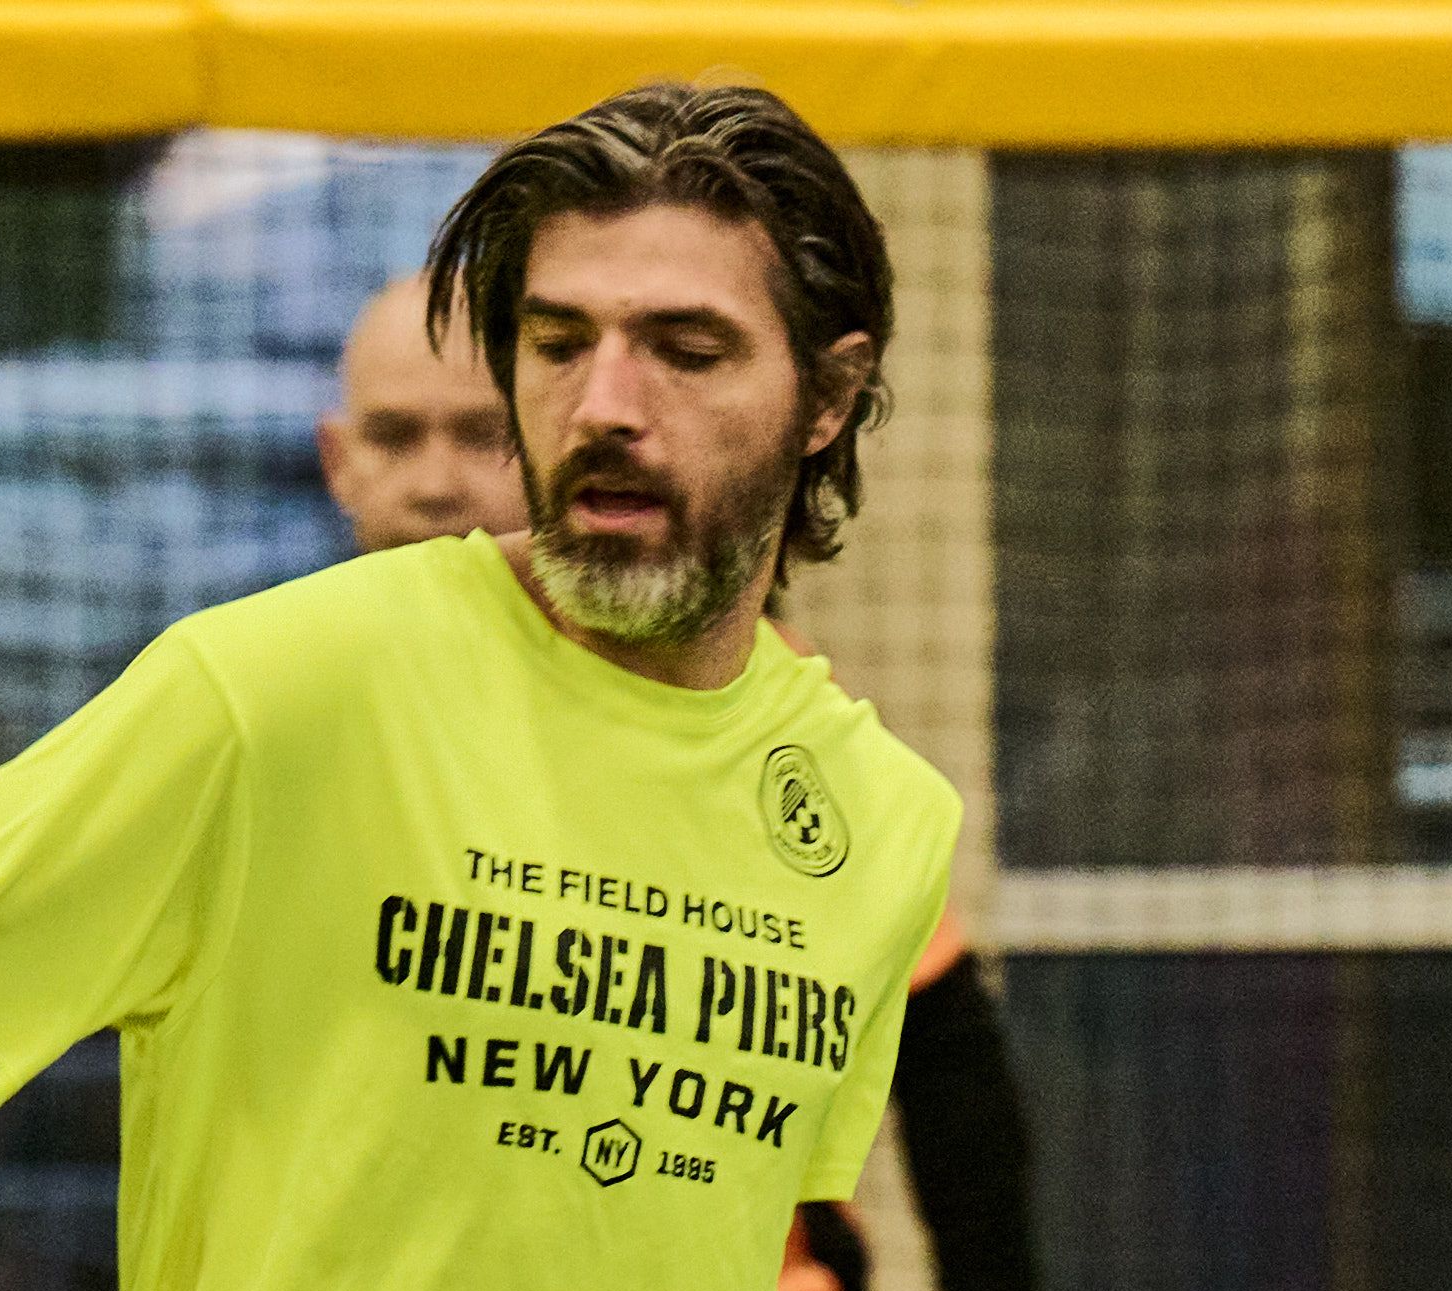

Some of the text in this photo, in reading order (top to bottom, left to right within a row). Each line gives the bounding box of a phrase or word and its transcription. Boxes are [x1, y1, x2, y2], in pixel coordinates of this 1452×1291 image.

[466, 848, 806, 950] THE FIELD HOUSE
[374, 895, 857, 1072] CHELSEA PIERS
[425, 1035, 799, 1149] NEW YORK
[594, 1137, 630, 1168] NY
